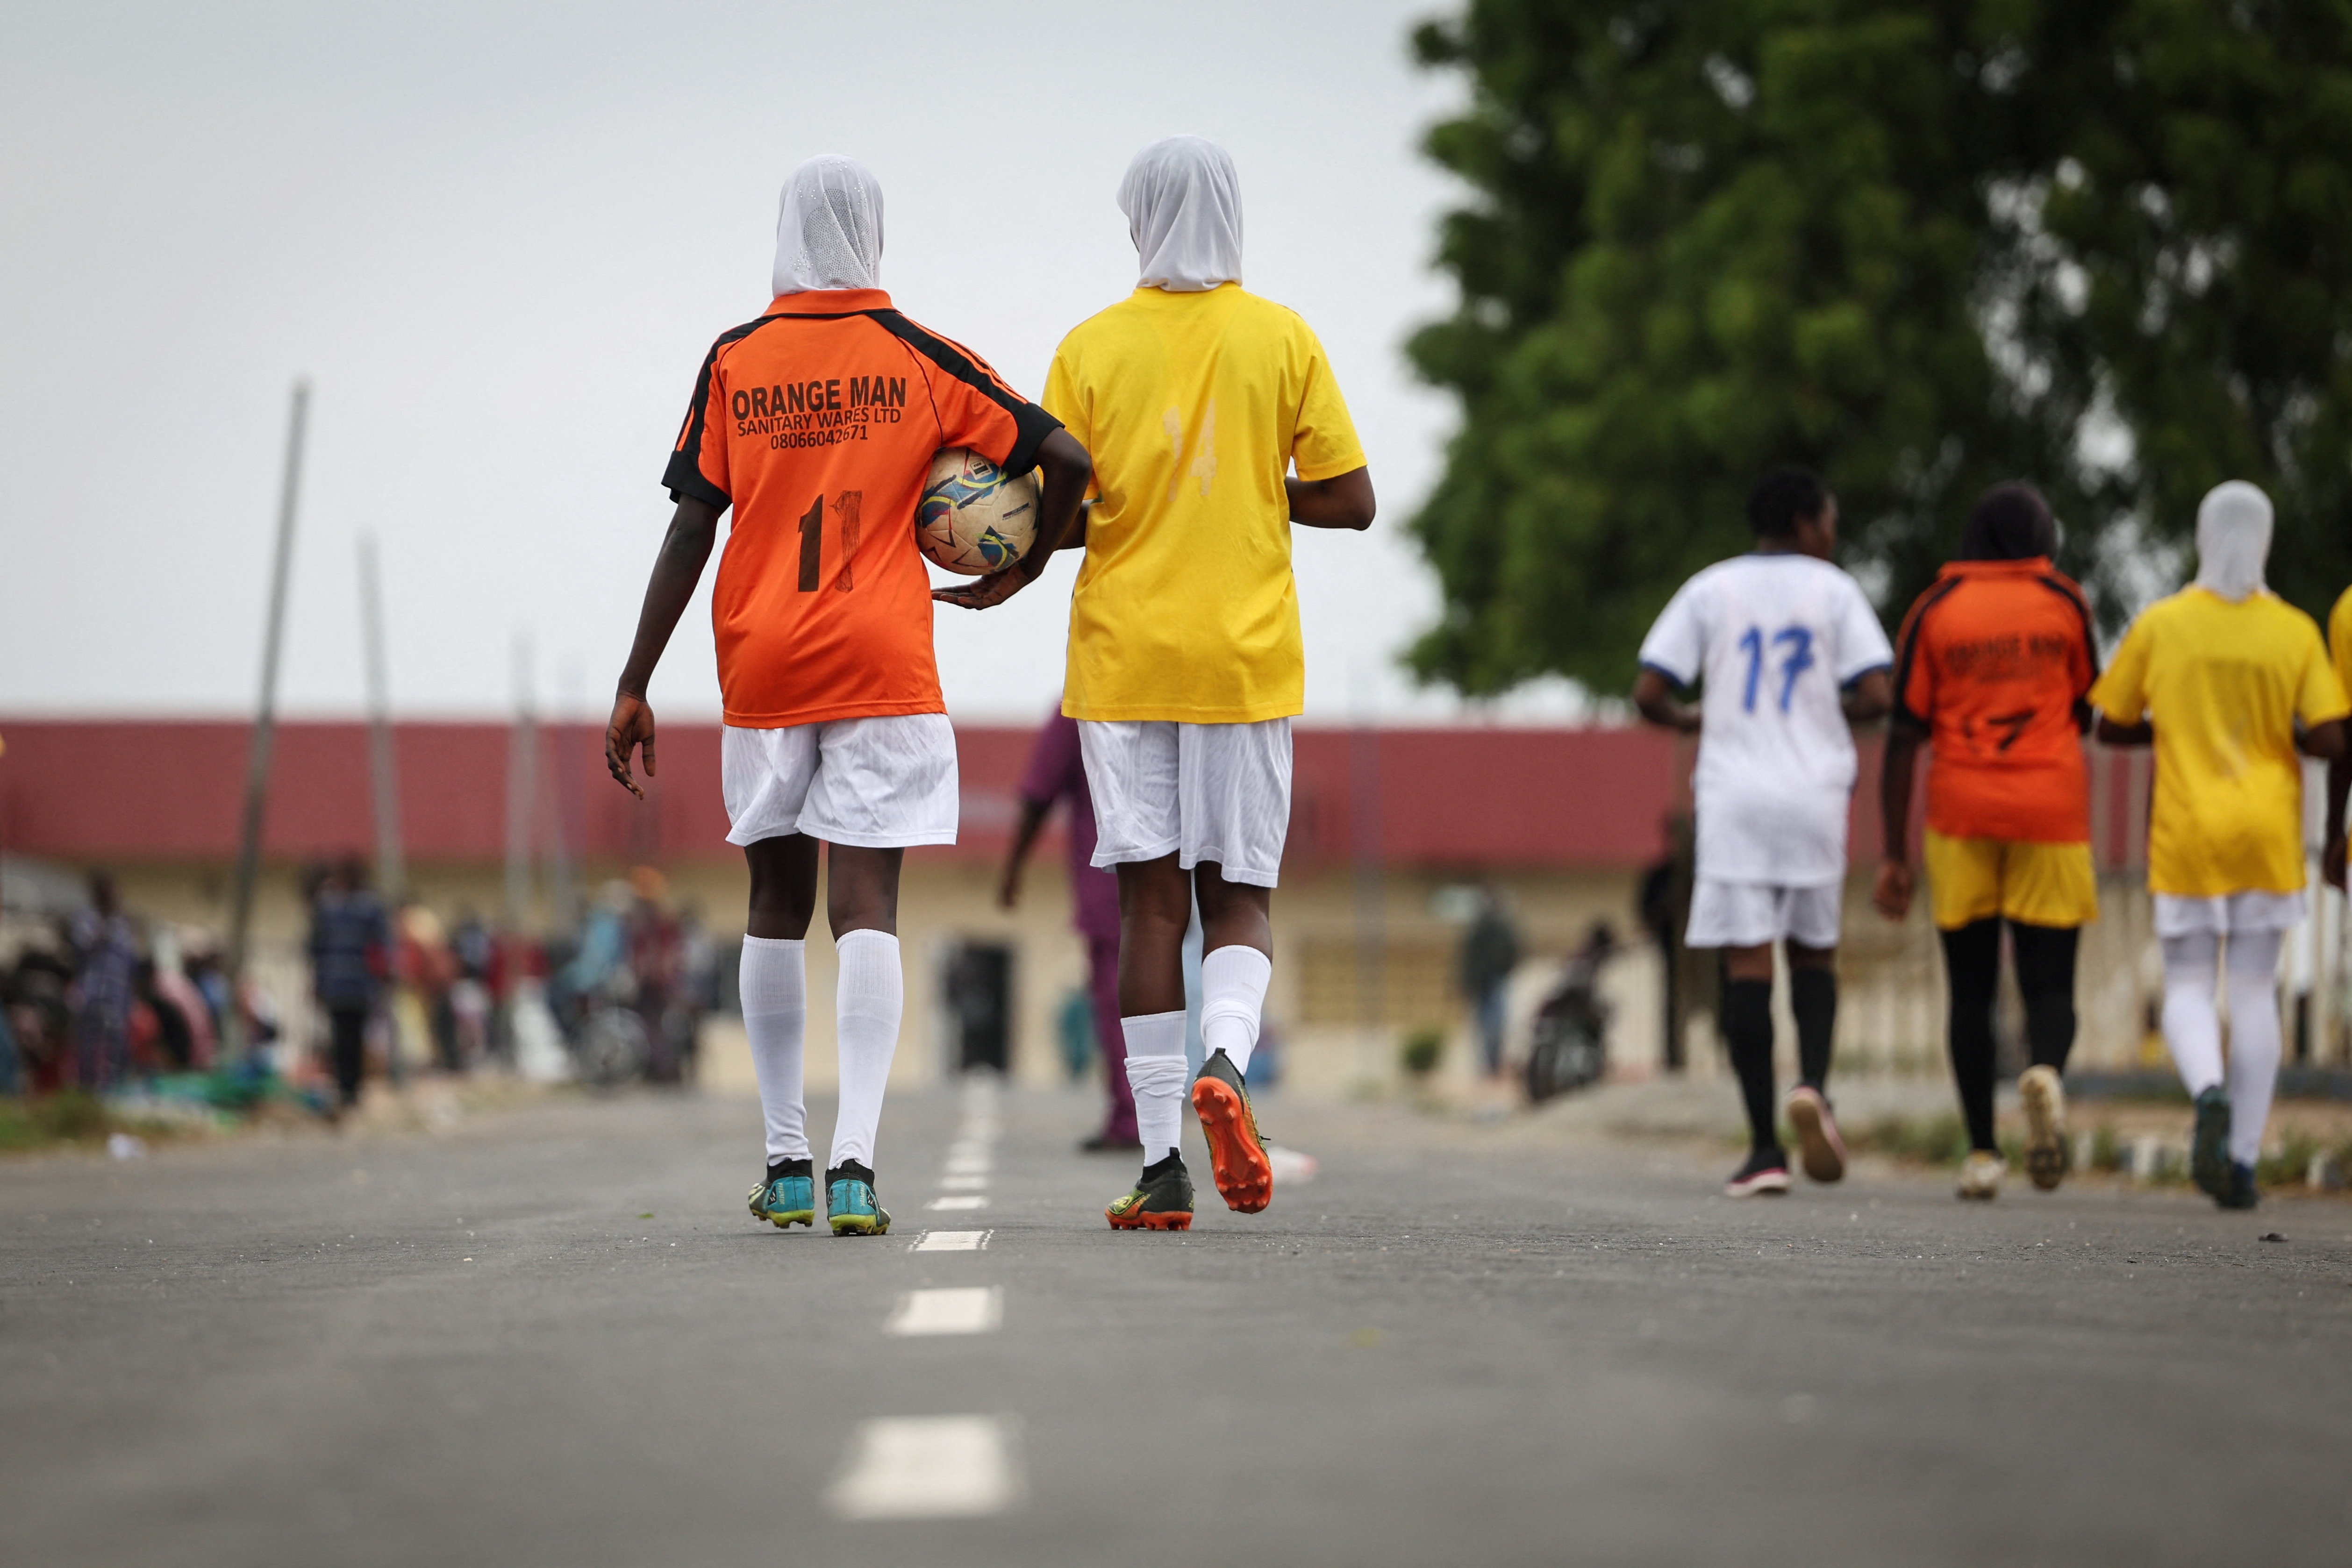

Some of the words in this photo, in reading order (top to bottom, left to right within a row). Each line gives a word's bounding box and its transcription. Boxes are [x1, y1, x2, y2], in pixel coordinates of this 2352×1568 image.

[732, 379, 841, 420] ORANGE
[850, 376, 906, 408] MAN
[737, 413, 811, 436] SANITARY
[817, 407, 869, 429] WARES
[874, 408, 901, 423] LTD
[771, 424, 868, 449] 08066042671
[1738, 625, 1815, 713] 17
